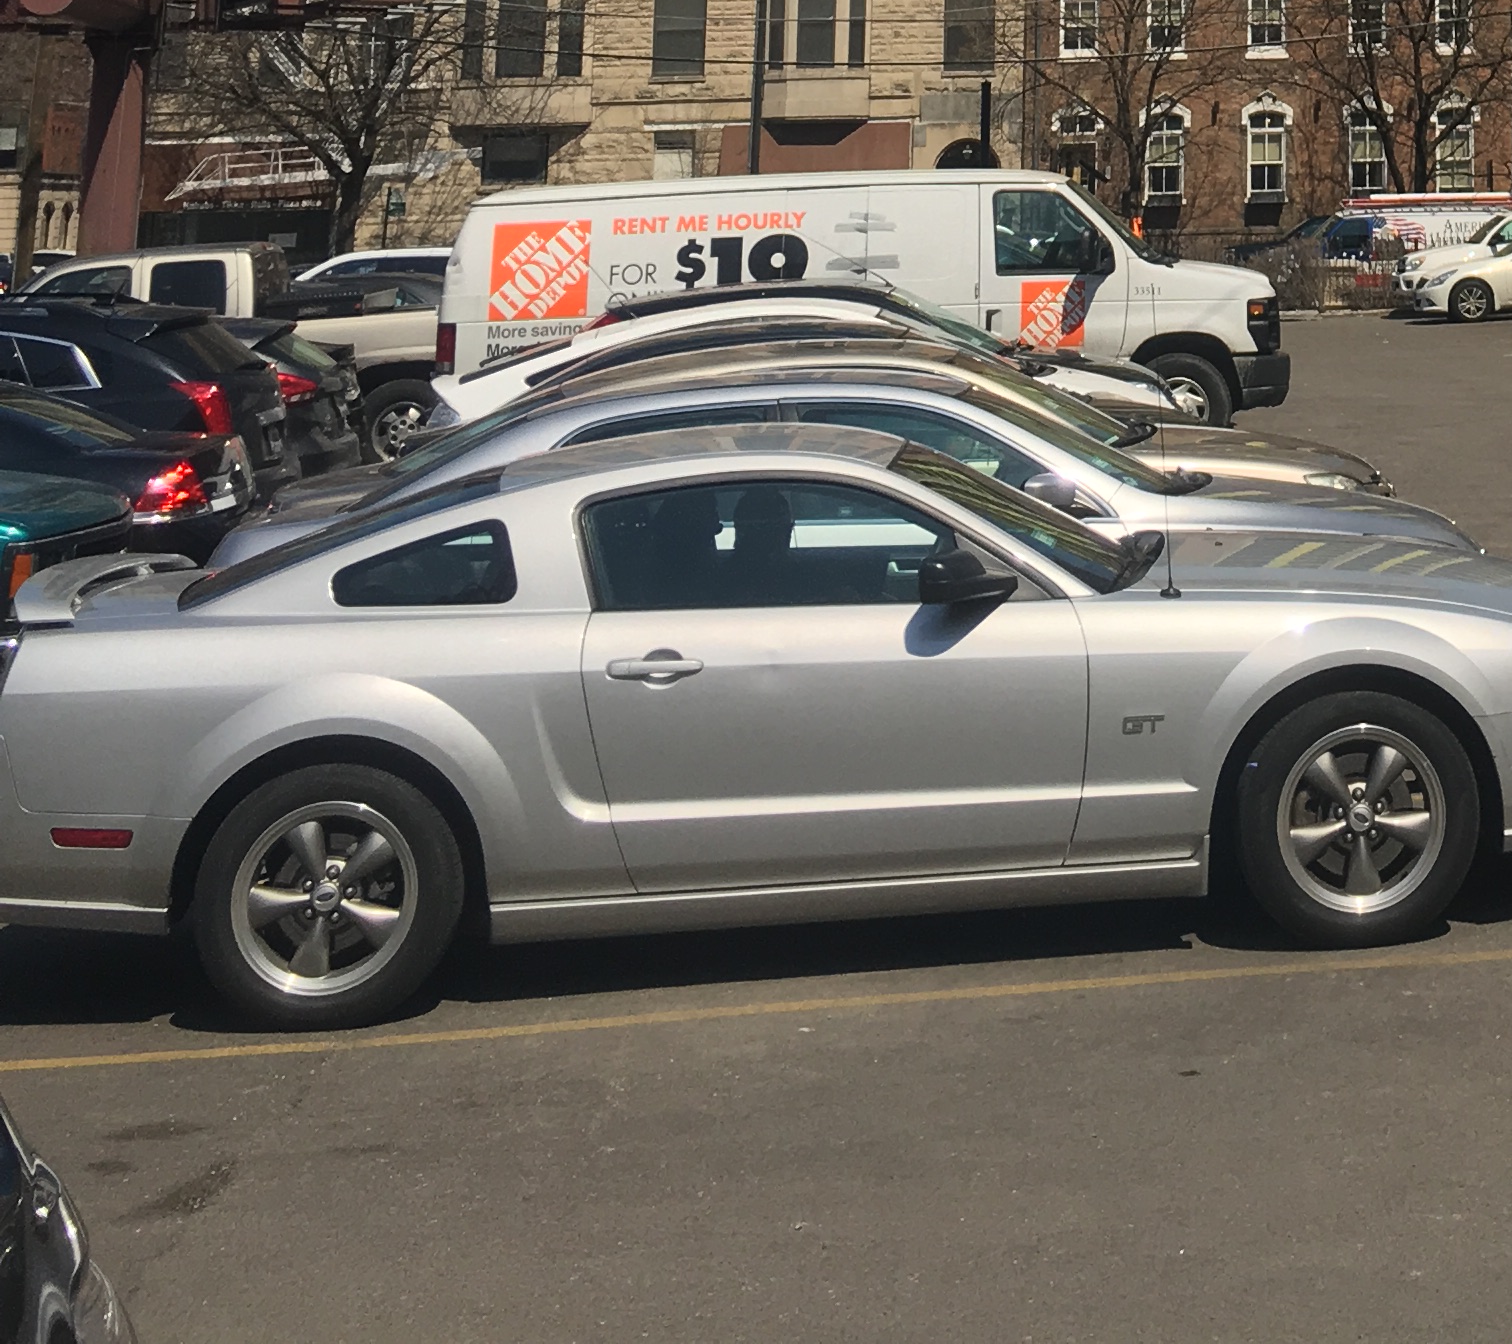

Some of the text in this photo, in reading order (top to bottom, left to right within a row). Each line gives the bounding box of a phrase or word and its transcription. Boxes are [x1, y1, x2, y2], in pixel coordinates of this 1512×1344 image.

[612, 211, 807, 235] RENT ME HOURLY
[501, 231, 545, 271] THE
[488, 220, 592, 320] HOME
[527, 254, 591, 319] DEPOT
[609, 263, 658, 286] FOR
[1020, 281, 1085, 347] HOME
[1027, 287, 1056, 315] THE
[487, 325, 527, 339] More
[1044, 304, 1086, 348] DEPOT
[1122, 714, 1165, 736] GT
